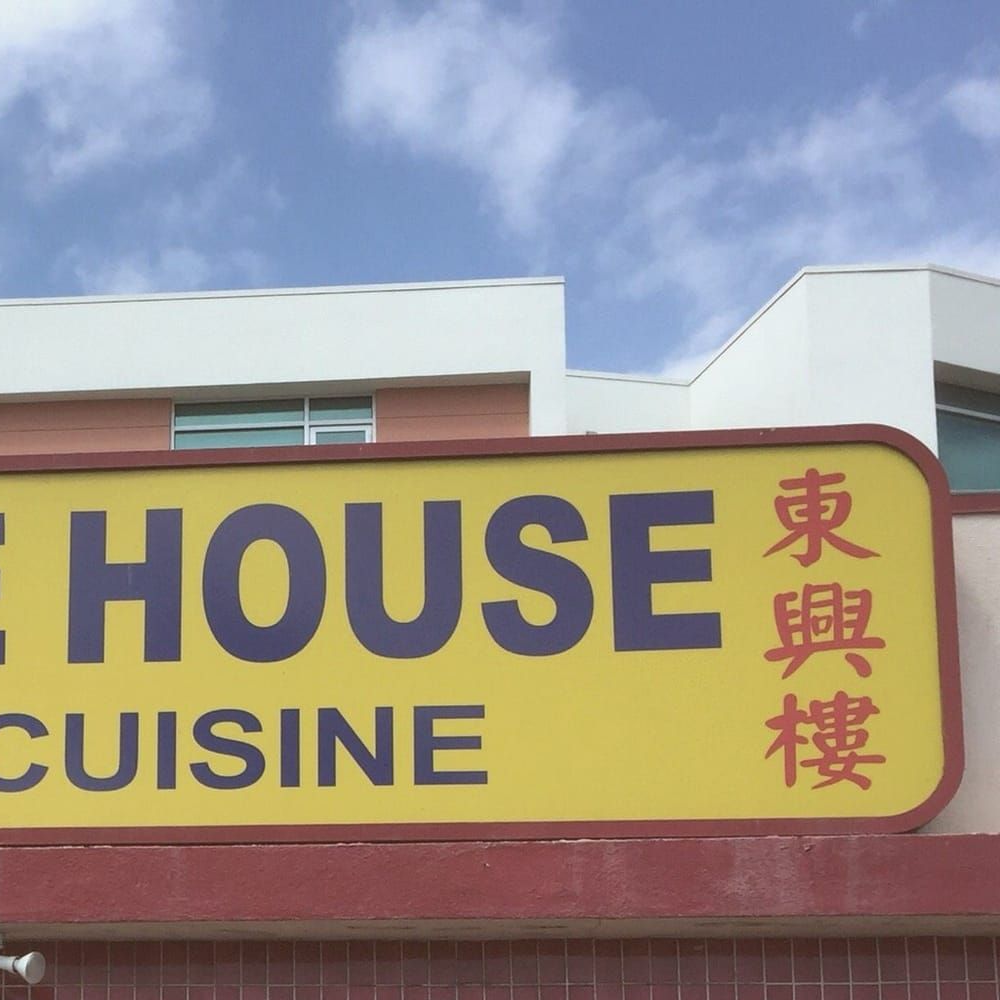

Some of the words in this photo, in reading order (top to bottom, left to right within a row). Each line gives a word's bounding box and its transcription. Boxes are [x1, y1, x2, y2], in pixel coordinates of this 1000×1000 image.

[68, 490, 722, 663] HOUSE
[763, 468, 886, 790] 東興樓
